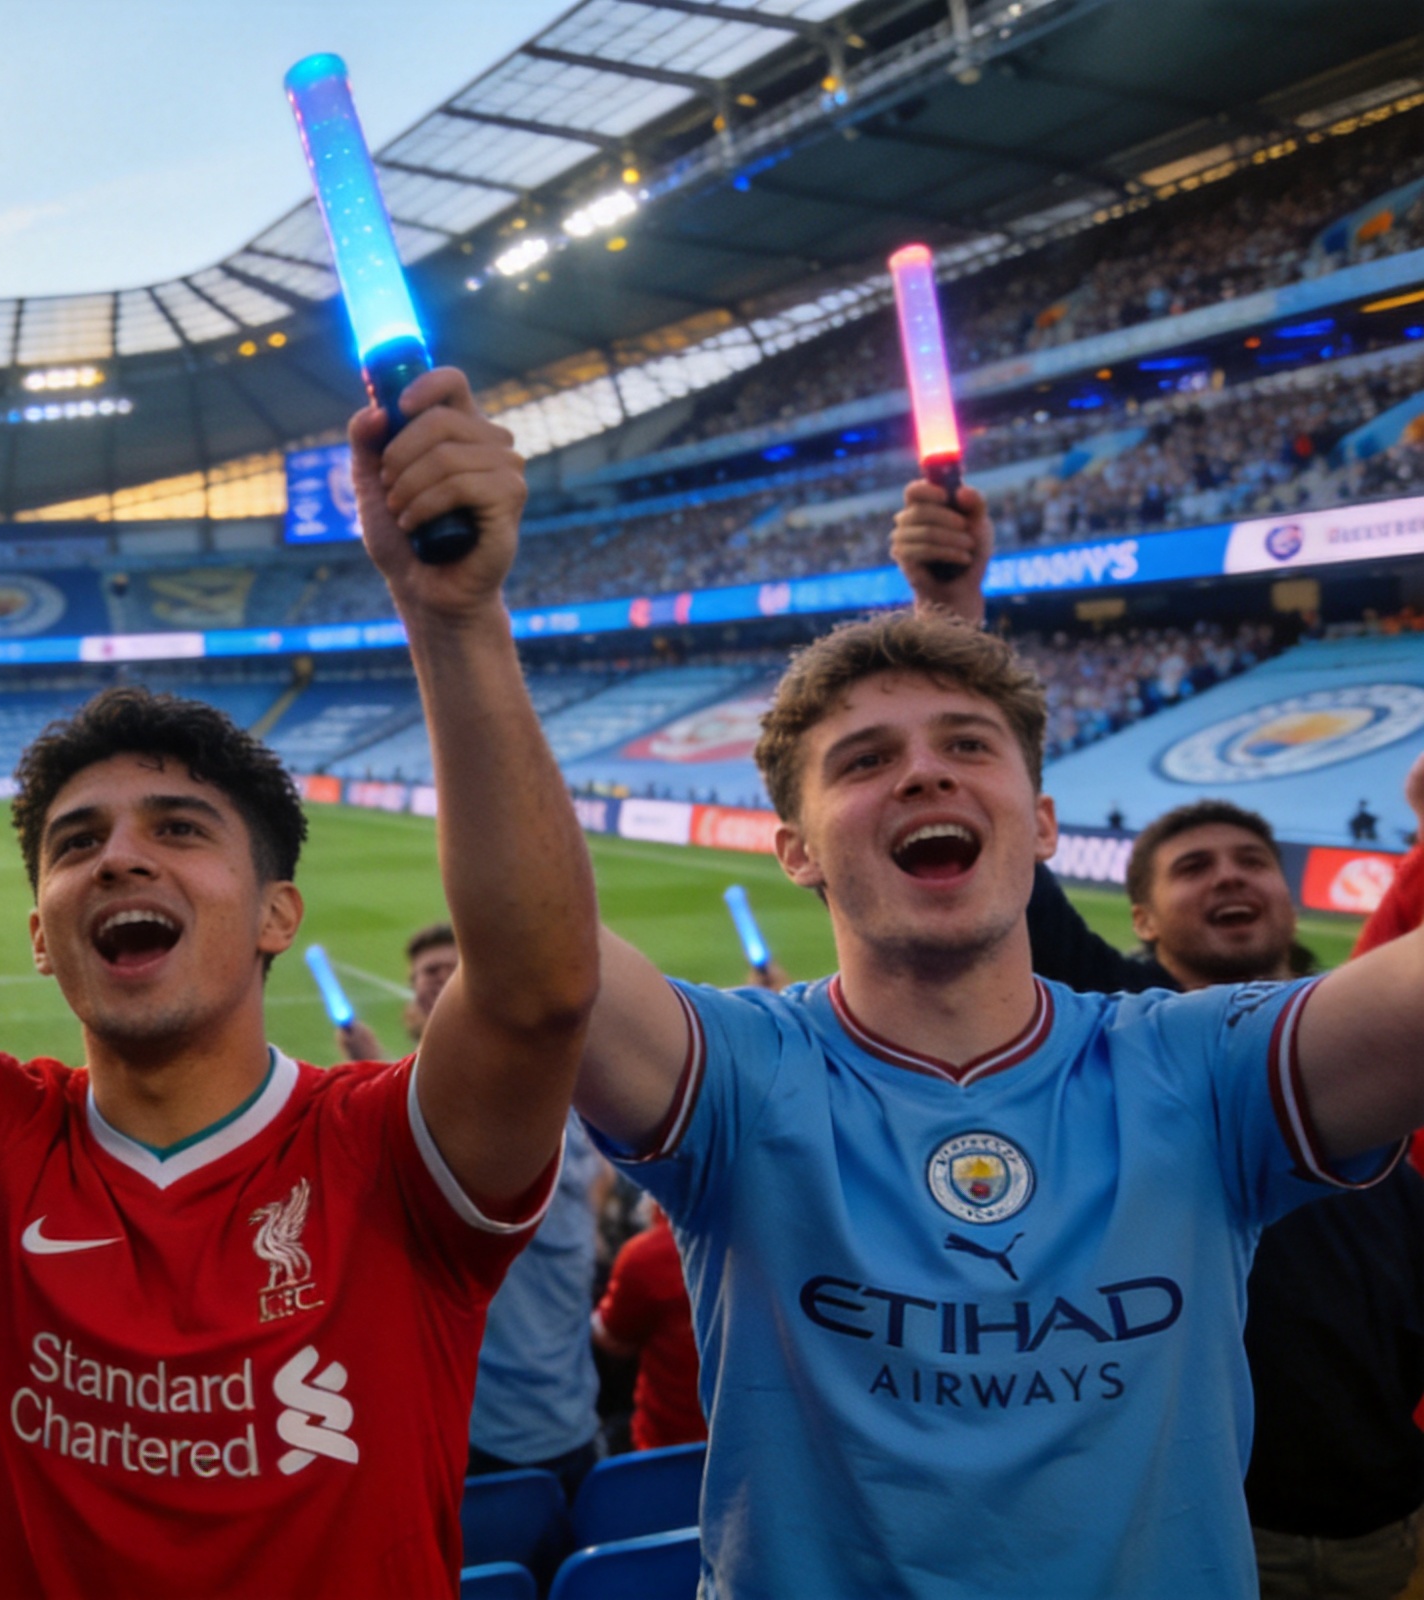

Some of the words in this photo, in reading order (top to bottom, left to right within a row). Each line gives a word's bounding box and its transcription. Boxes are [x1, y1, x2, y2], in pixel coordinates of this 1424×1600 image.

[799, 1274, 1183, 1354] ETIHAD
[29, 1331, 255, 1413] Standard
[869, 1362, 1125, 1409] AIRWAYS
[10, 1387, 260, 1477] Chartered
